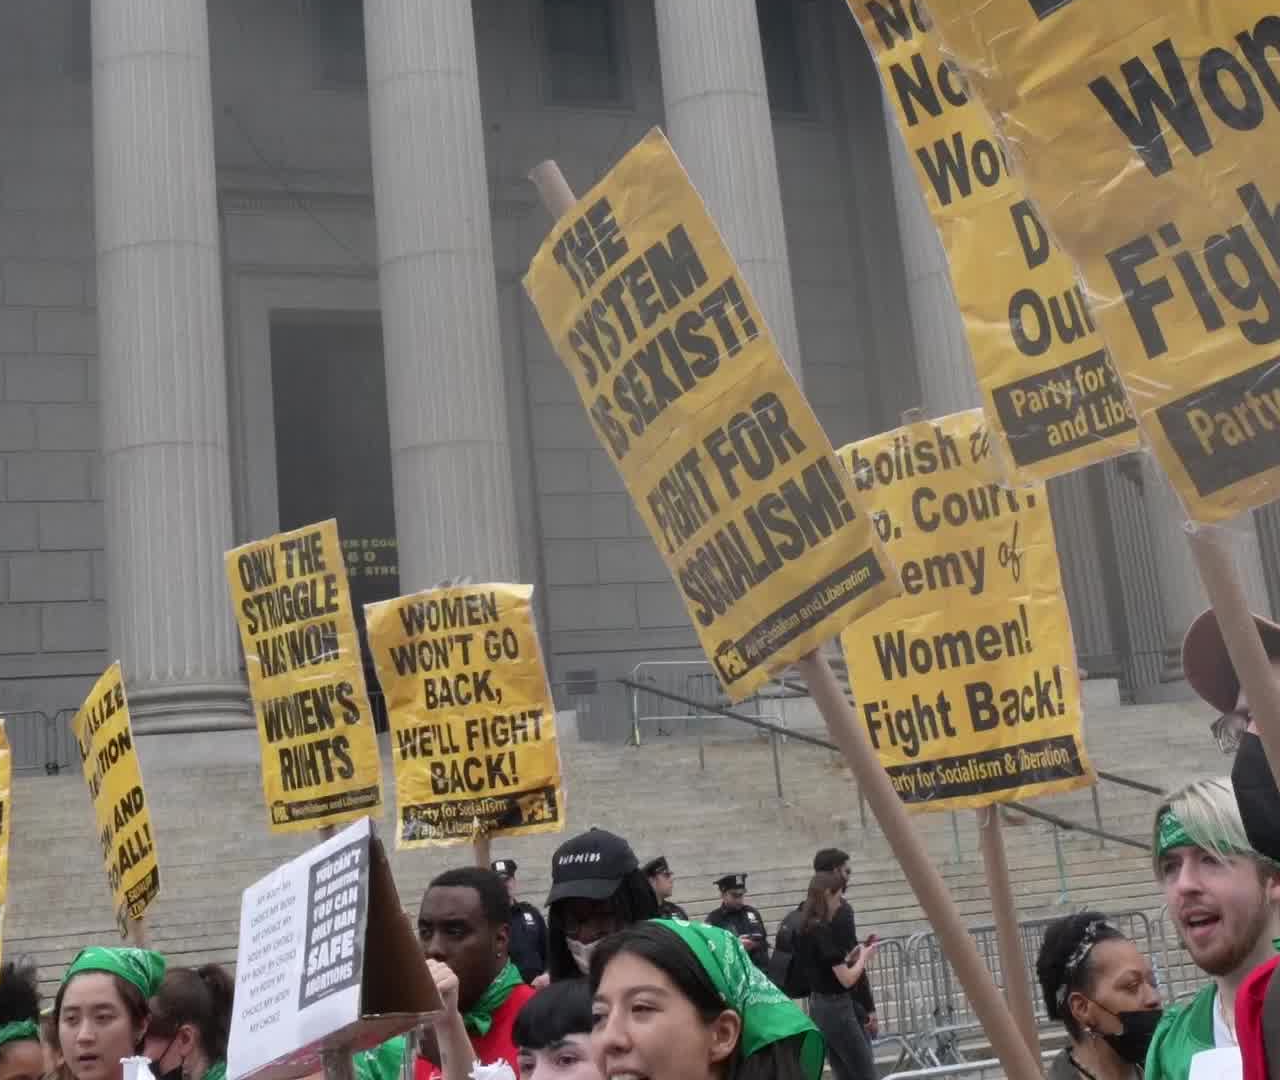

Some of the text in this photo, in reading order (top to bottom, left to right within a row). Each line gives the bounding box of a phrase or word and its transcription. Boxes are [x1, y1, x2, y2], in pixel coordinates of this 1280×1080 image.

[552, 196, 629, 300] THE
[568, 224, 709, 388] SYSTEM
[612, 274, 760, 428] SEXIST!
[1008, 376, 1072, 418] Party
[1075, 363, 1106, 393] for
[1046, 406, 1089, 448] and
[646, 391, 807, 556] FIGHT FOR
[839, 426, 961, 491] bolish
[237, 531, 327, 593] ONLY THE
[677, 454, 857, 627] SOCIALISM!
[900, 519, 1024, 596] emy of
[241, 573, 339, 636] STRUGGLE
[397, 591, 499, 637] WOMEN
[799, 600, 824, 619] and
[821, 566, 871, 607] Liberation
[255, 620, 340, 680] HAS WON
[390, 627, 519, 678] WON'T GO
[872, 603, 1033, 681] Women!
[425, 670, 503, 712] BACK,
[862, 664, 1066, 758] Fight Back!
[396, 708, 544, 761] WE'LL FIGHT
[430, 752, 520, 796] BACK!
[887, 772, 917, 794] arty
[916, 766, 938, 789] for
[938, 758, 1007, 786] Socialism
[1004, 752, 1017, 775] &
[440, 803, 457, 818] for
[118, 821, 154, 876] ALL!
[333, 885, 360, 912] CAN
[304, 959, 355, 1000] ABORTIONS
[307, 928, 357, 977] SAFE
